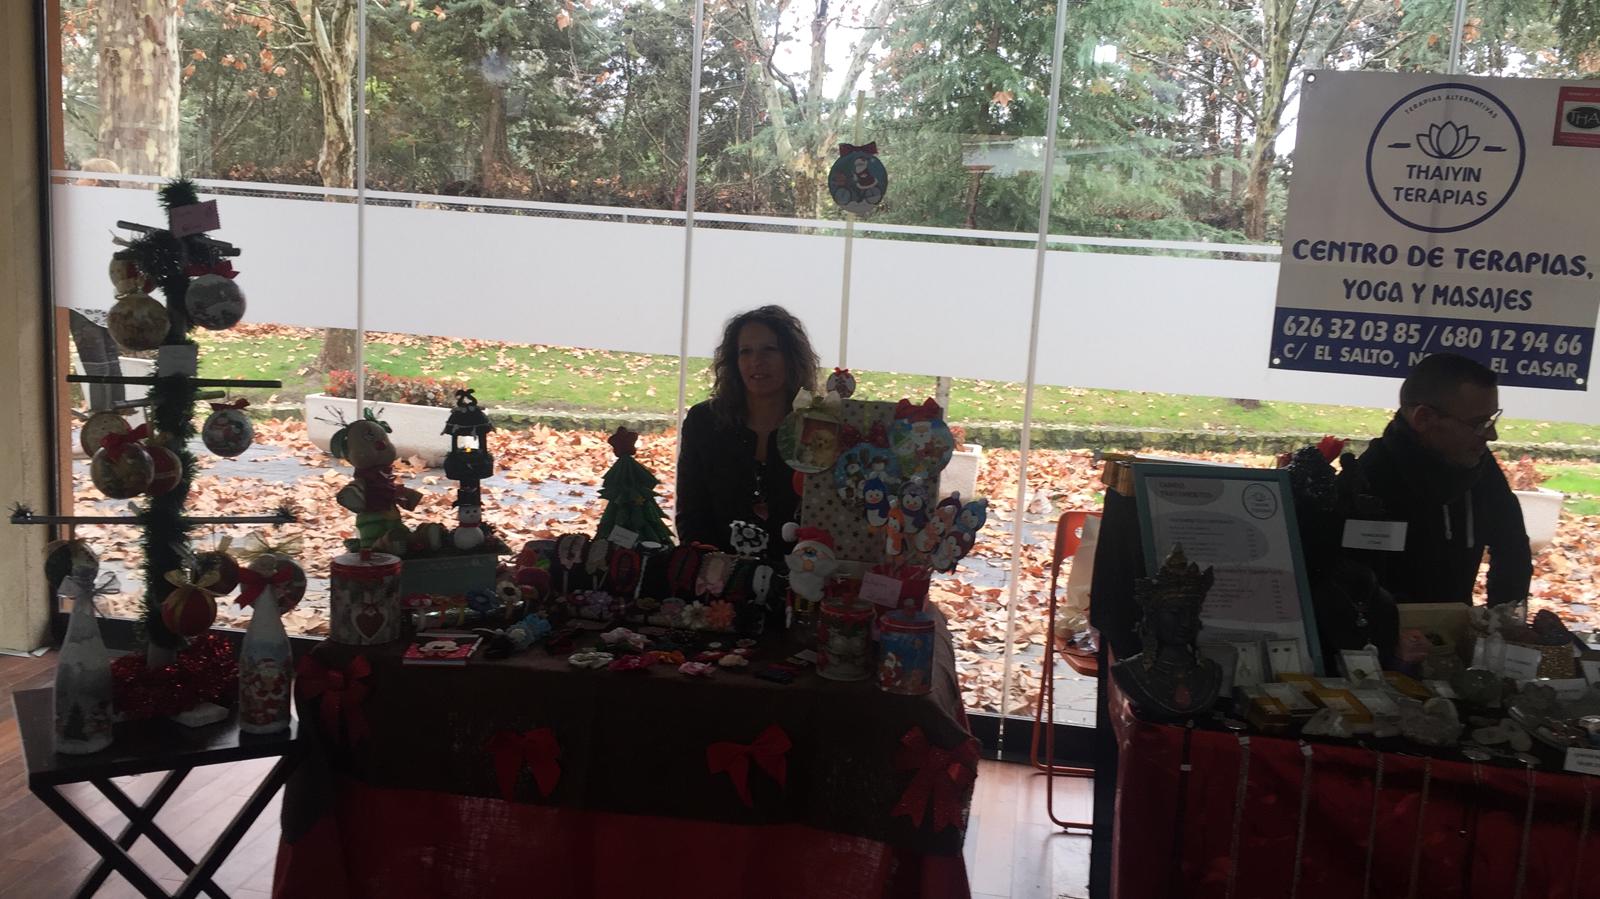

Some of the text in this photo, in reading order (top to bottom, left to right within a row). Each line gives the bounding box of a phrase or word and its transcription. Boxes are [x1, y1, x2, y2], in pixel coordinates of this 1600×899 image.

[1406, 164, 1482, 183] THAIYIN
[1393, 187, 1487, 206] TERAPIAS
[1292, 239, 1593, 280] CENTRO DE TERAPIAS,
[1342, 279, 1532, 312] YOGA Y MASAJES
[1283, 316, 1322, 338] 626
[1328, 319, 1355, 339] 32
[1360, 321, 1388, 342] 03
[1394, 323, 1421, 344] 85
[1441, 325, 1482, 348] 680
[1490, 329, 1514, 350] 12
[1521, 332, 1548, 353] 94
[1554, 334, 1582, 355] 66
[1283, 342, 1307, 360] C/
[1314, 345, 1332, 360] EL
[1340, 347, 1399, 368] SALTO,
[1491, 358, 1508, 373] EL
[1517, 360, 1578, 378] CASAR
